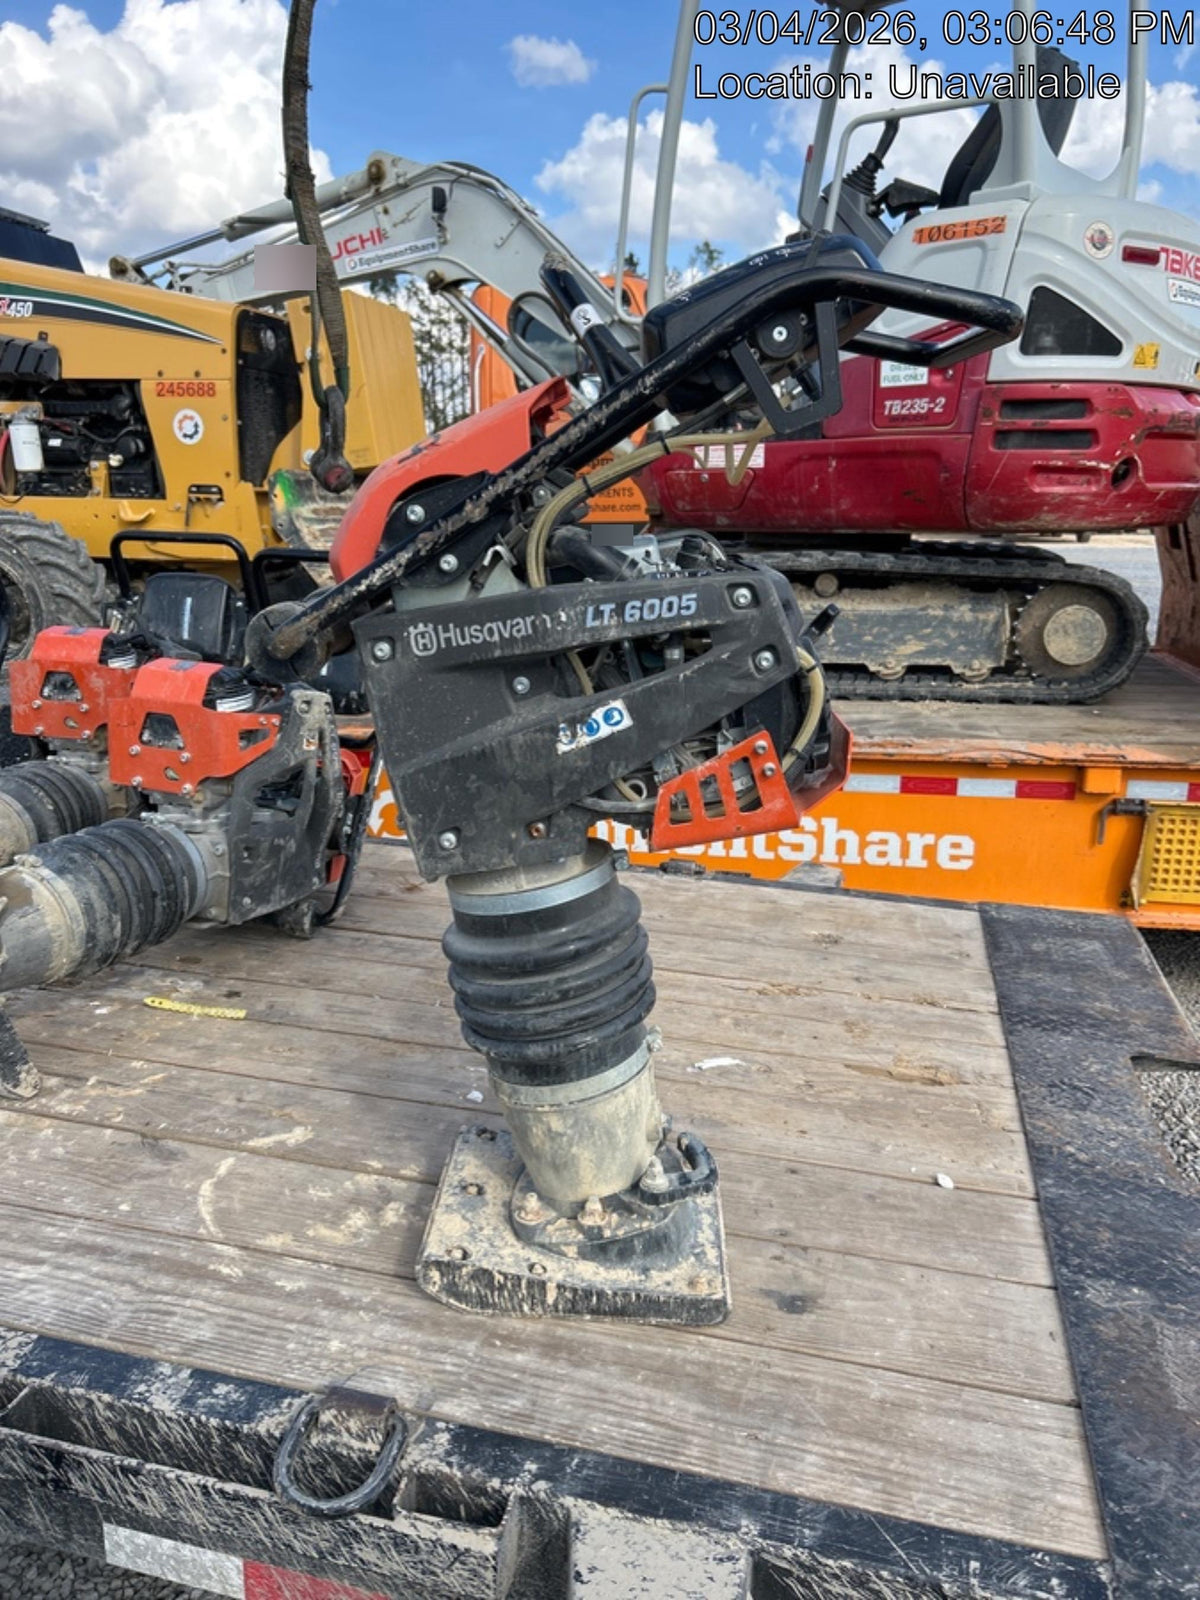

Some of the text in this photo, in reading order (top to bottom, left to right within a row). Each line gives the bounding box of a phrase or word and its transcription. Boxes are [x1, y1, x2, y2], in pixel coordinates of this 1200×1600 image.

[914, 215, 1007, 244] 106152
[156, 382, 217, 398] 245688
[884, 396, 947, 416] TB235-2
[586, 604, 613, 628] LT
[624, 593, 698, 623] 6005
